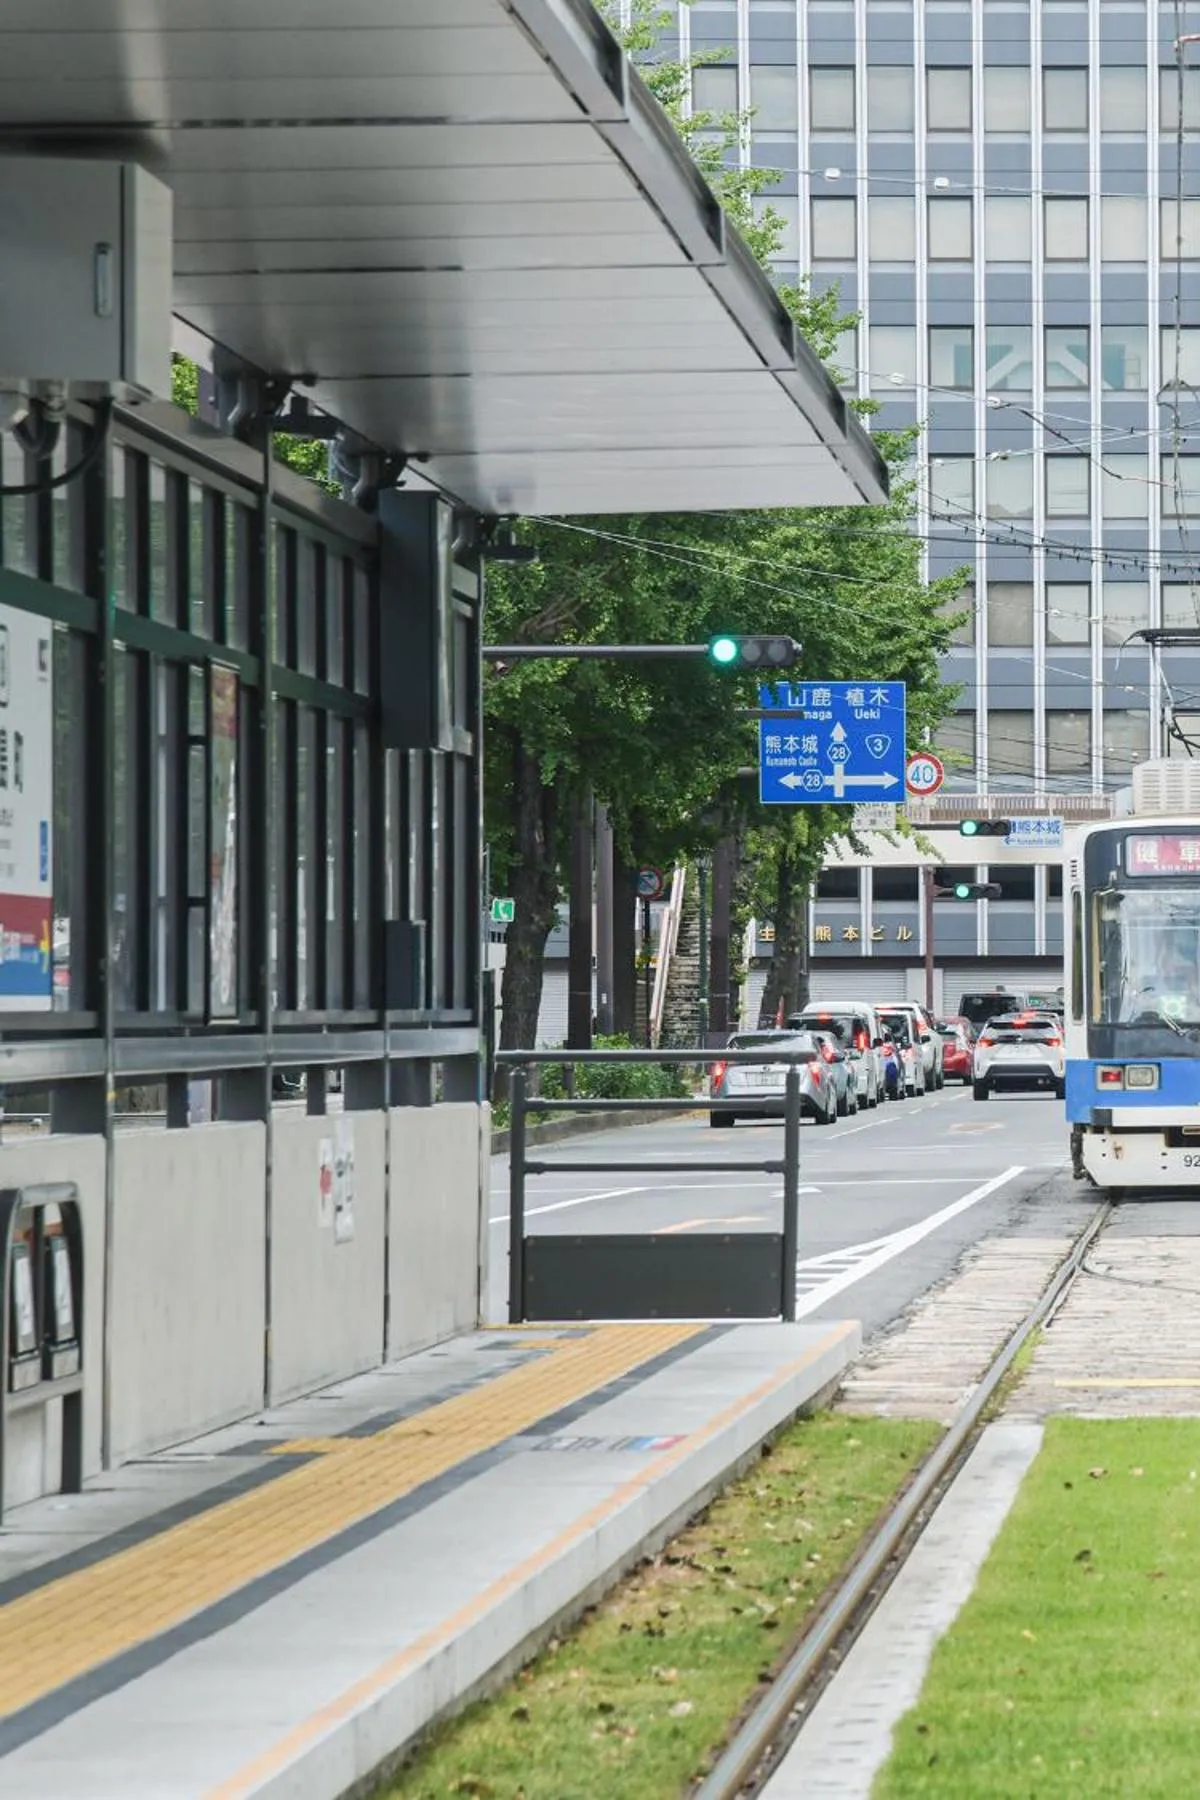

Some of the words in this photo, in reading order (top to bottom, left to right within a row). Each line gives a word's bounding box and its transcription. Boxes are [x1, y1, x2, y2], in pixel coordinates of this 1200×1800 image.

[788, 687, 831, 707] 山鹿
[845, 687, 889, 706] 植木
[855, 708, 880, 719] Ueki
[765, 735, 818, 754] 熊本城
[873, 739, 883, 752] 3
[832, 747, 845, 760] 28
[806, 774, 820, 786] 28
[910, 765, 934, 784] 40
